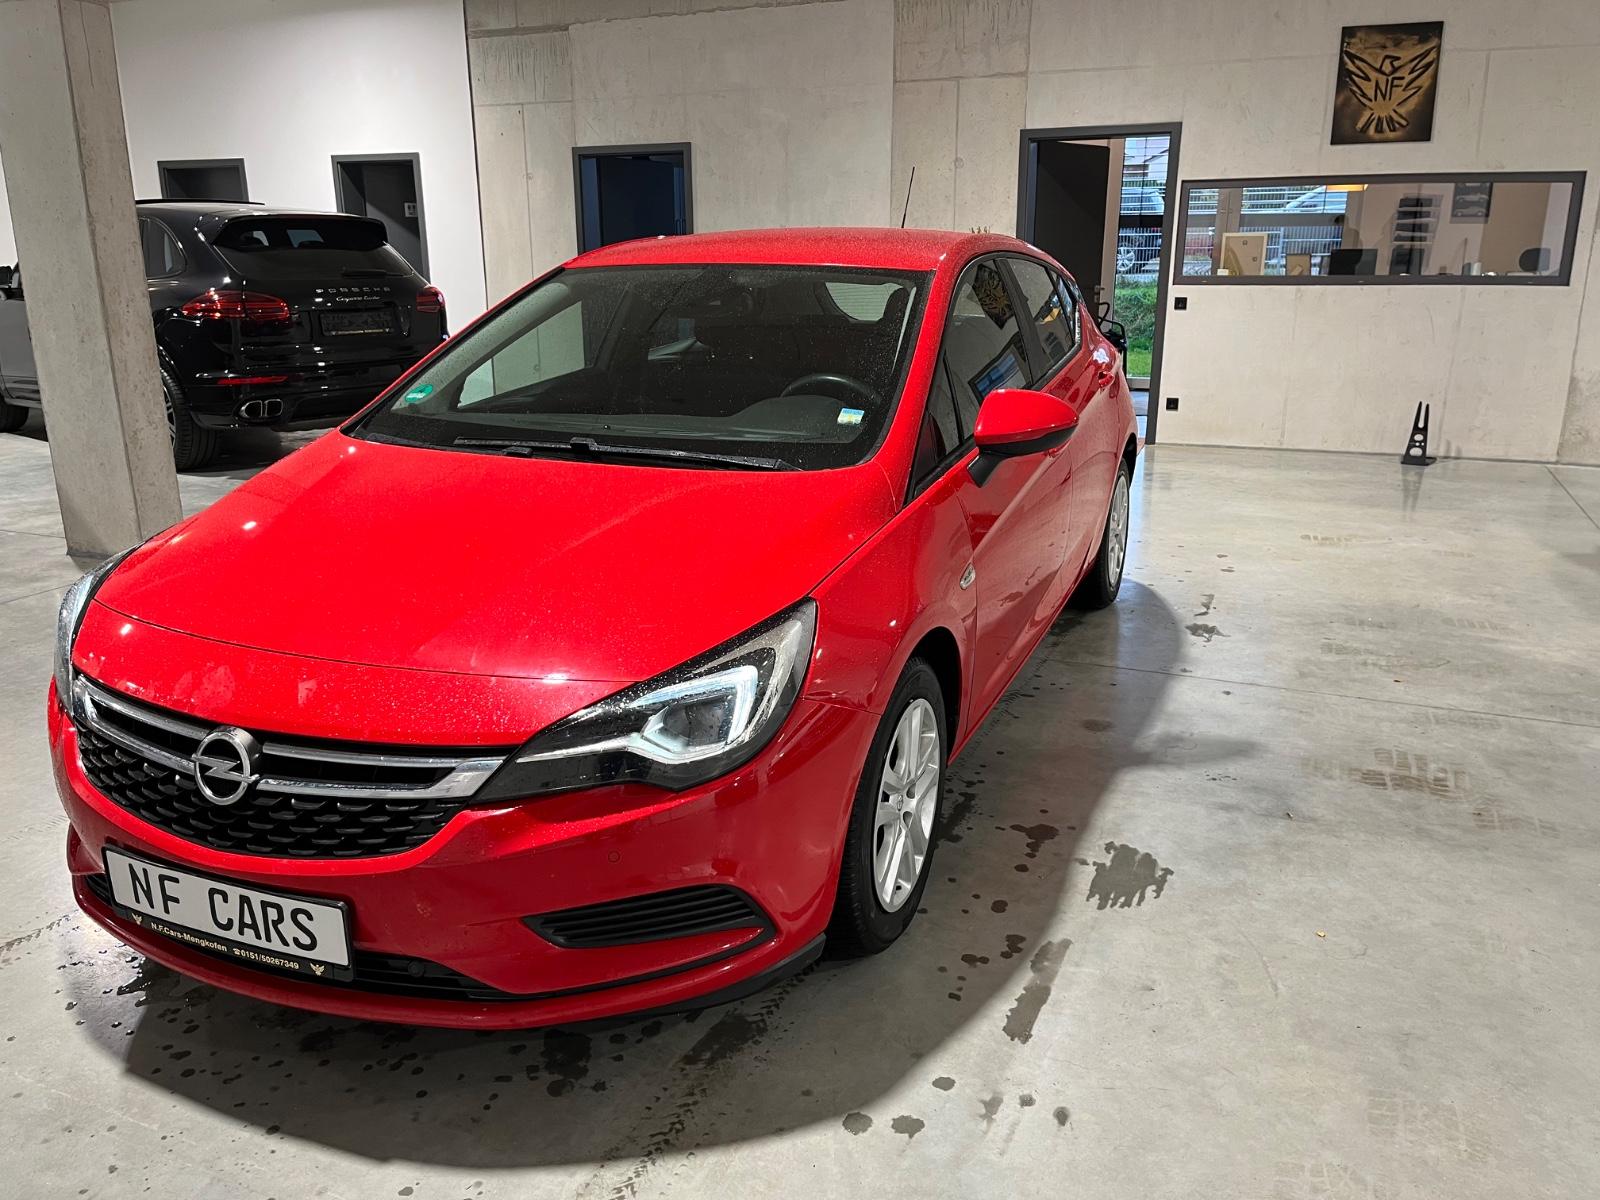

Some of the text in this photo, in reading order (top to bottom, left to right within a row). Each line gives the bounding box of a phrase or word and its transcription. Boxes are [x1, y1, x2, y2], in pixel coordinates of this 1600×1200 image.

[1373, 76, 1405, 102] NF
[128, 863, 318, 951] NF CARS
